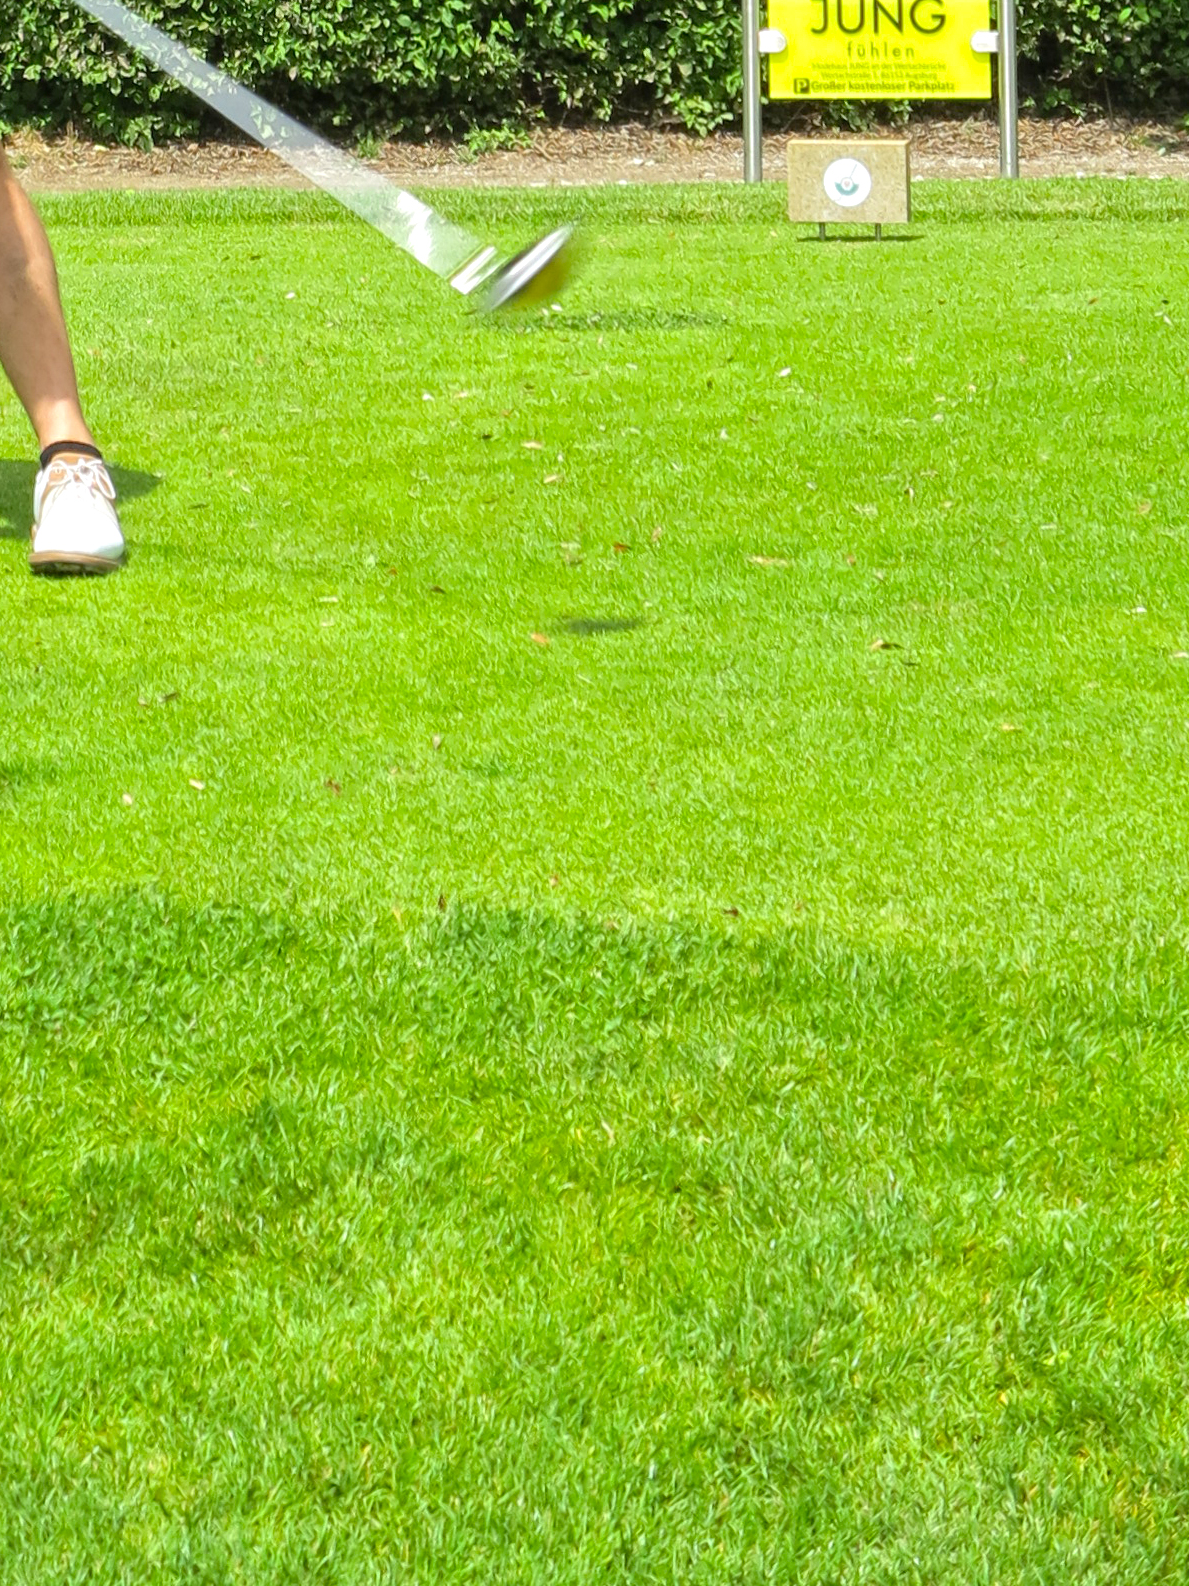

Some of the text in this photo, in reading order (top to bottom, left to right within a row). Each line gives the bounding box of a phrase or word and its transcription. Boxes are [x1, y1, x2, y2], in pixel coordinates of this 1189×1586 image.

[847, 41, 915, 58] fühlen
[811, 81, 846, 91] Großer
[848, 80, 906, 91] kostenloser
[908, 80, 955, 92] Parkplatz
